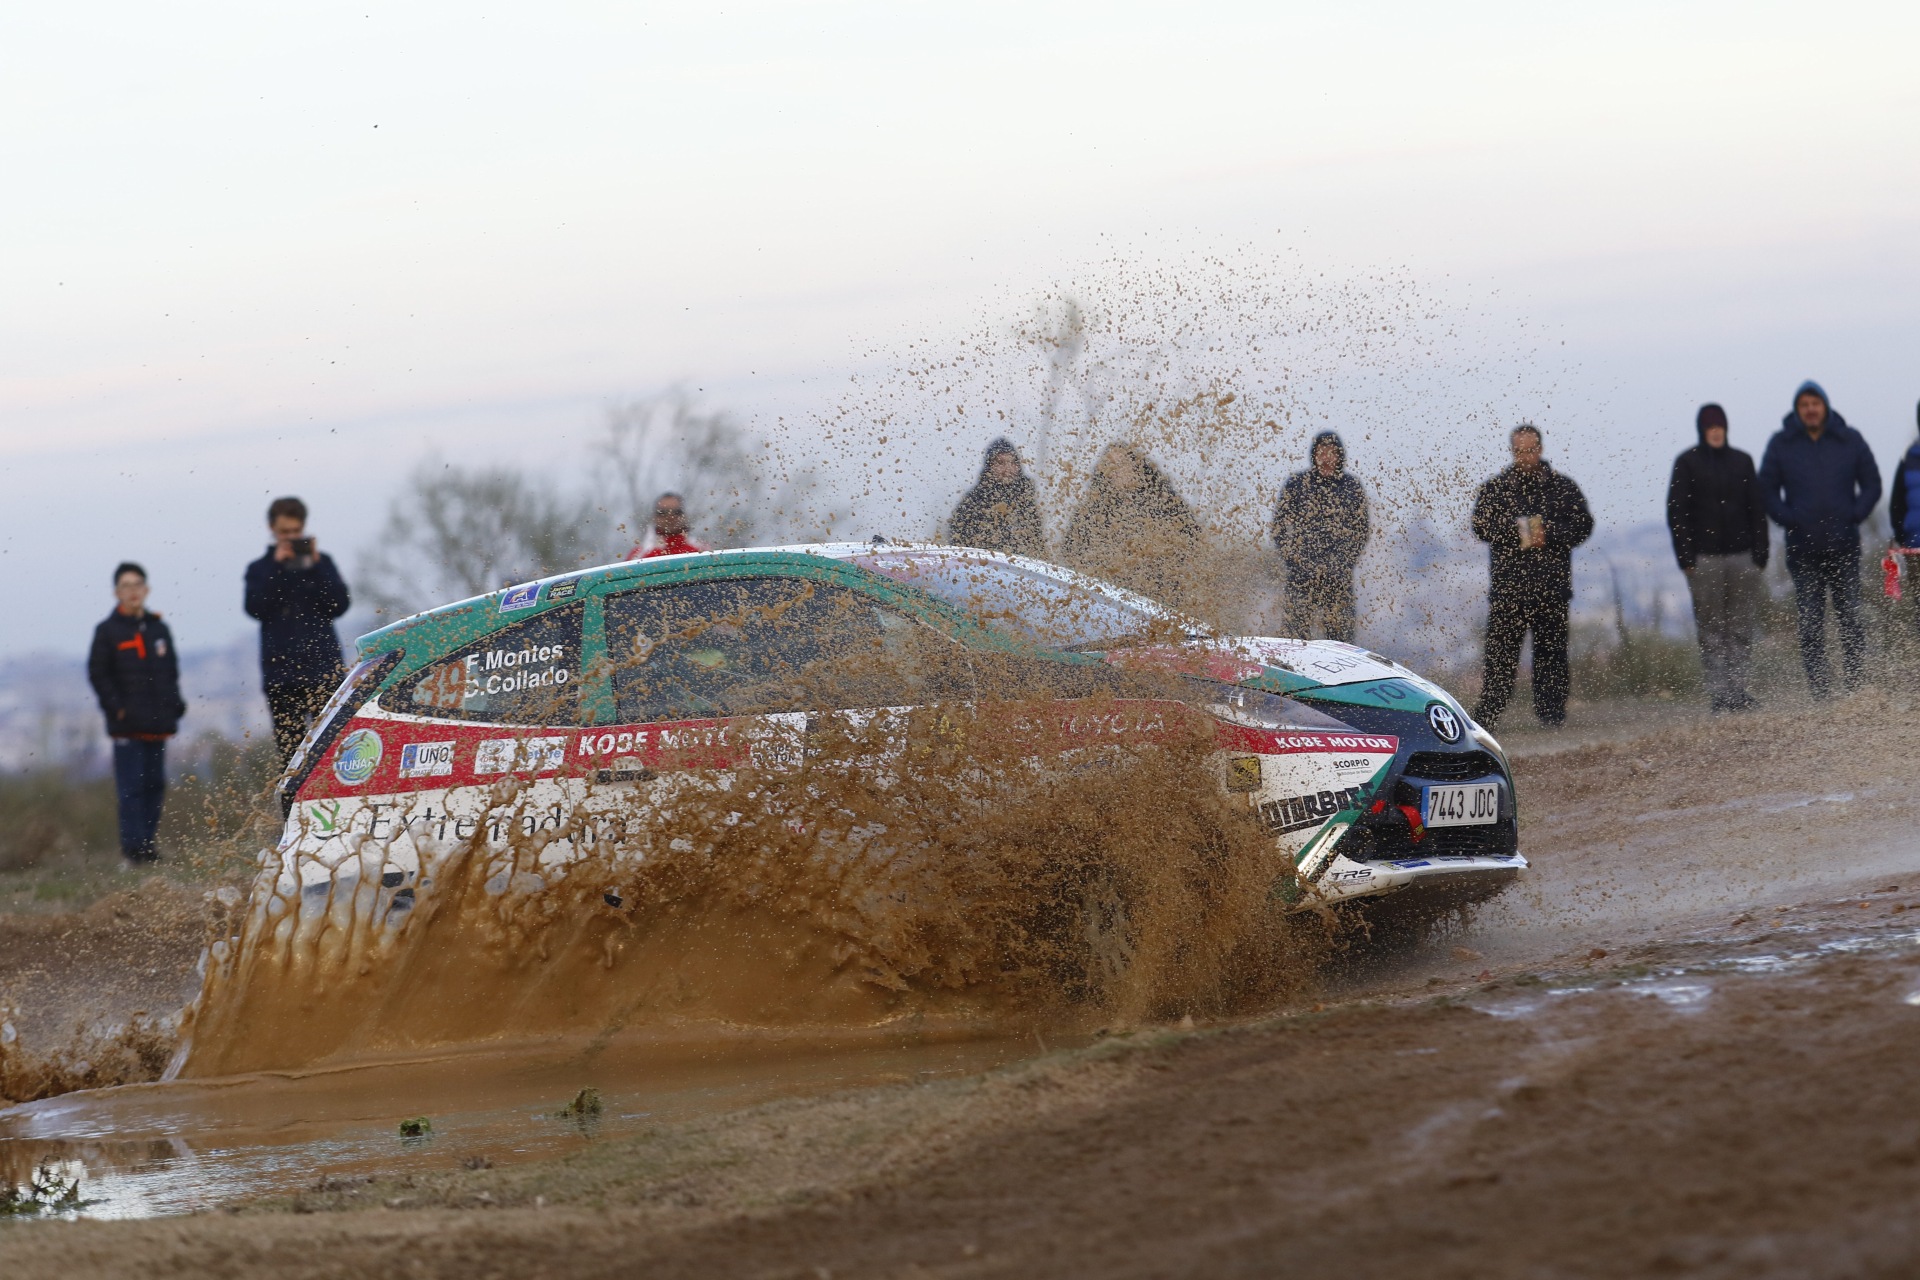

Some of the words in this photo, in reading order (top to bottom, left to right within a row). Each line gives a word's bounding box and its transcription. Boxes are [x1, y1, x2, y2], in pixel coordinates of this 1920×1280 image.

[466, 644, 564, 673] F.Montes
[578, 731, 648, 756] KOBE
[1275, 737, 1323, 749] KOBE
[1328, 737, 1393, 749] MOTOR
[419, 746, 449, 764] UNO
[1333, 758, 1370, 769] SCORPIO
[400, 768, 451, 778] UOMATICULA
[1430, 790, 1464, 821] 7443
[1470, 788, 1495, 818] JDC
[1331, 868, 1373, 880] TRS
